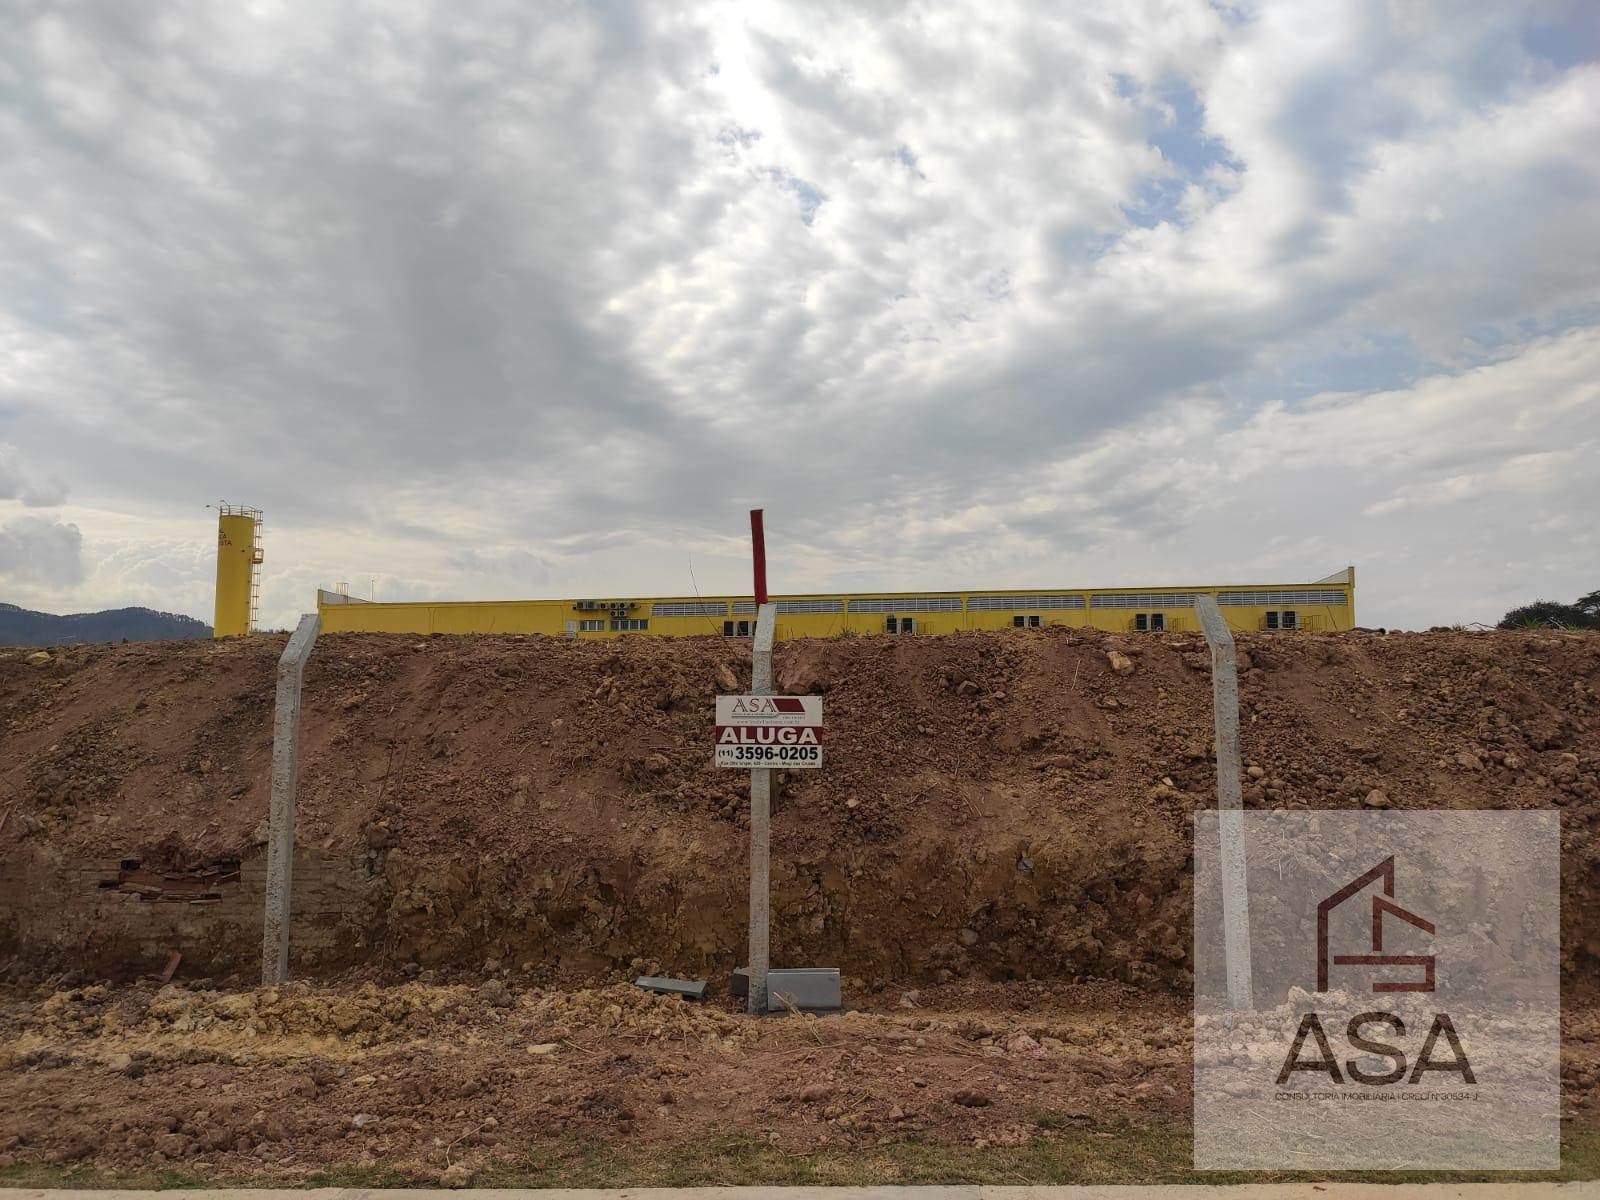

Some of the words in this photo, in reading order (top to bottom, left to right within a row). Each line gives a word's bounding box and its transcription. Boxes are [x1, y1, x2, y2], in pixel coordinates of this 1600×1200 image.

[732, 698, 777, 712] ASA
[719, 727, 819, 744] ALUGA
[718, 749, 733, 758] (11)
[735, 746, 818, 760] 3596-0205
